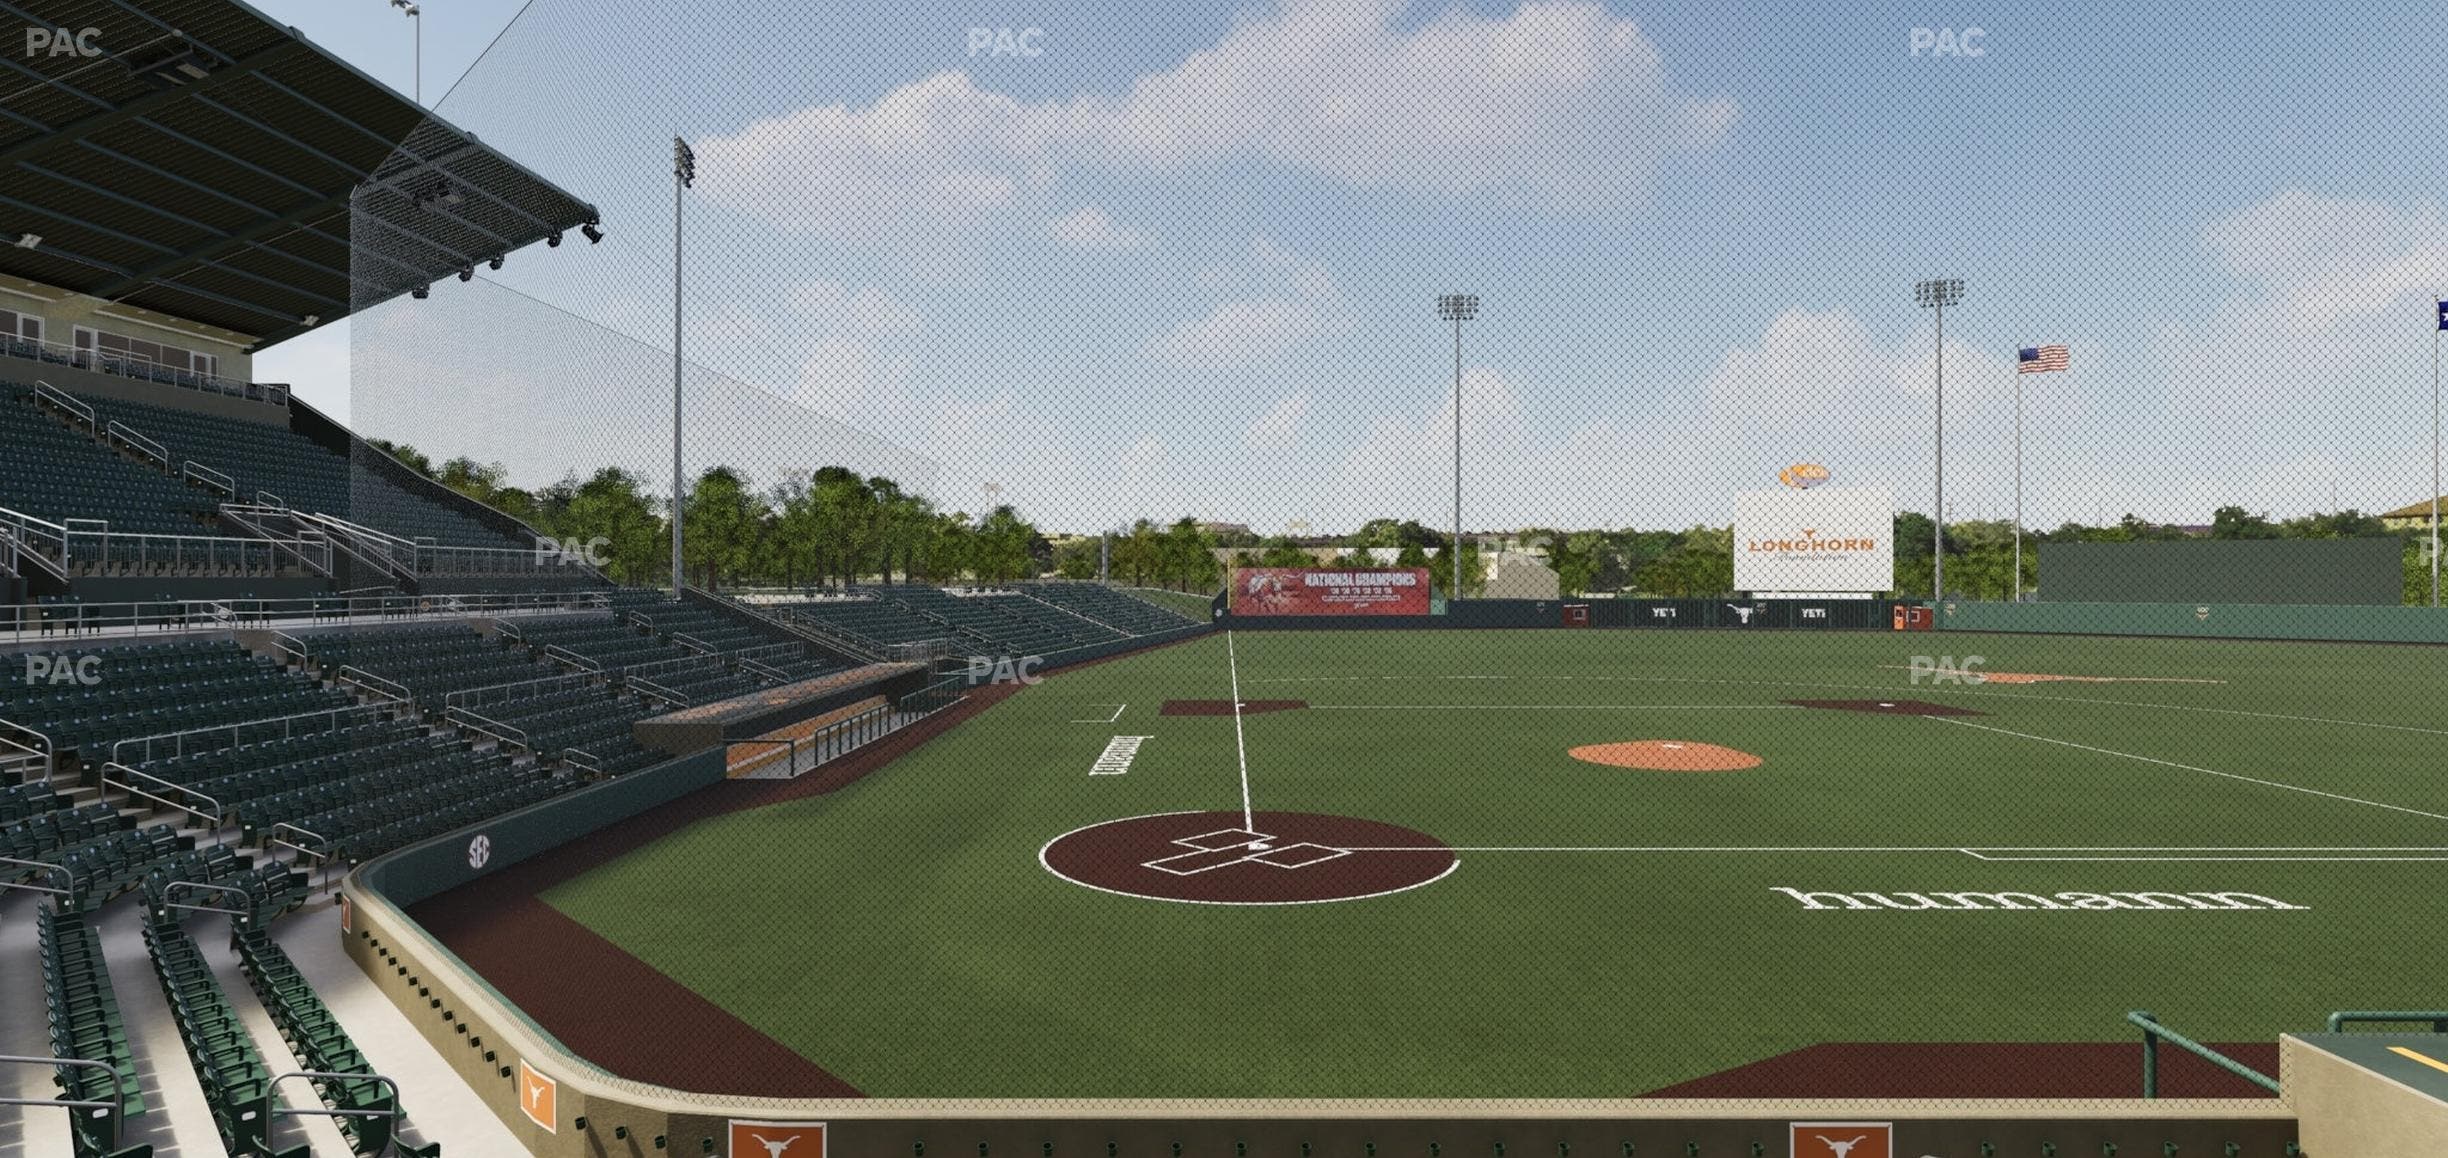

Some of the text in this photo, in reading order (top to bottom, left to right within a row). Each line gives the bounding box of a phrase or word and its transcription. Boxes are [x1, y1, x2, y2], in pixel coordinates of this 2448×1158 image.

[1748, 539, 1874, 552] LONGHORN
[1305, 573, 1416, 586] NATIONAL CHAMPIONS
[1801, 608, 1826, 618] YETI
[469, 835, 490, 868] SEC
[1769, 887, 2311, 909] humann
